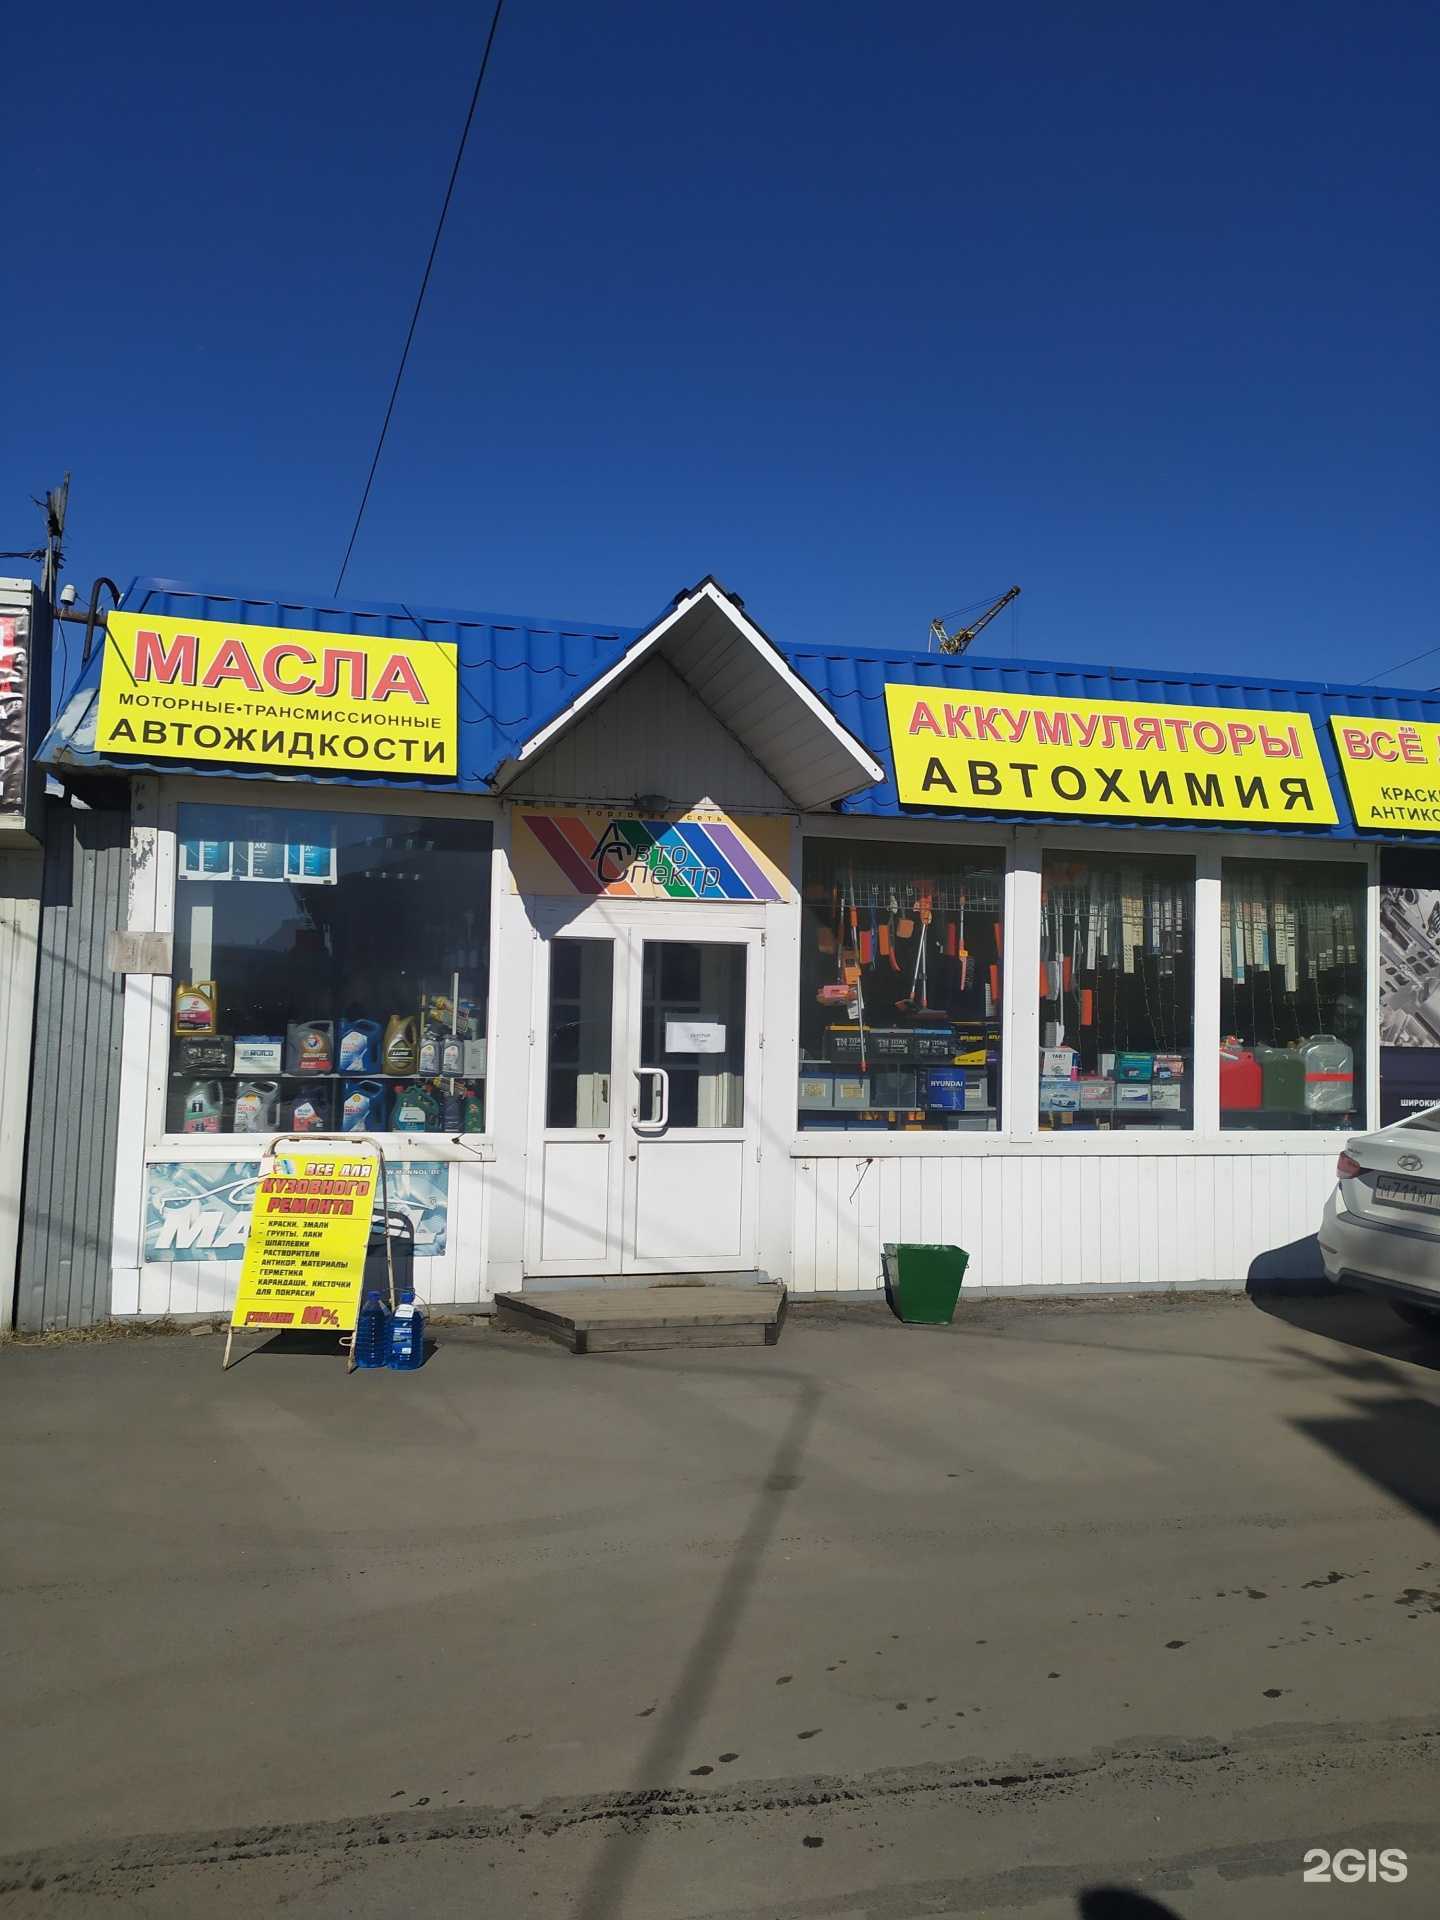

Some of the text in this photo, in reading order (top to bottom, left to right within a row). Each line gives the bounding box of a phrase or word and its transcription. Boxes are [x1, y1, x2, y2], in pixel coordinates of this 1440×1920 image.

[134, 629, 430, 704] МАСЛА
[908, 700, 1302, 759] АККУМУЛЯТОРЫ
[108, 718, 446, 763] АВТОЖИДКОСТИ
[1342, 726, 1428, 764] ВСЁ
[921, 757, 1314, 811] АВТОХИМИЯ
[305, 1163, 372, 1177] ВСЕ ДЛЯ
[262, 1178, 370, 1196] КУЗОВНОГО
[266, 1197, 353, 1215] РЕМОНТА
[301, 1260, 349, 1268] МАТЕРИАЛЫ
[275, 1289, 316, 1297] ПОКРАСКИ
[312, 1280, 351, 1288] КИСТОЧКИ
